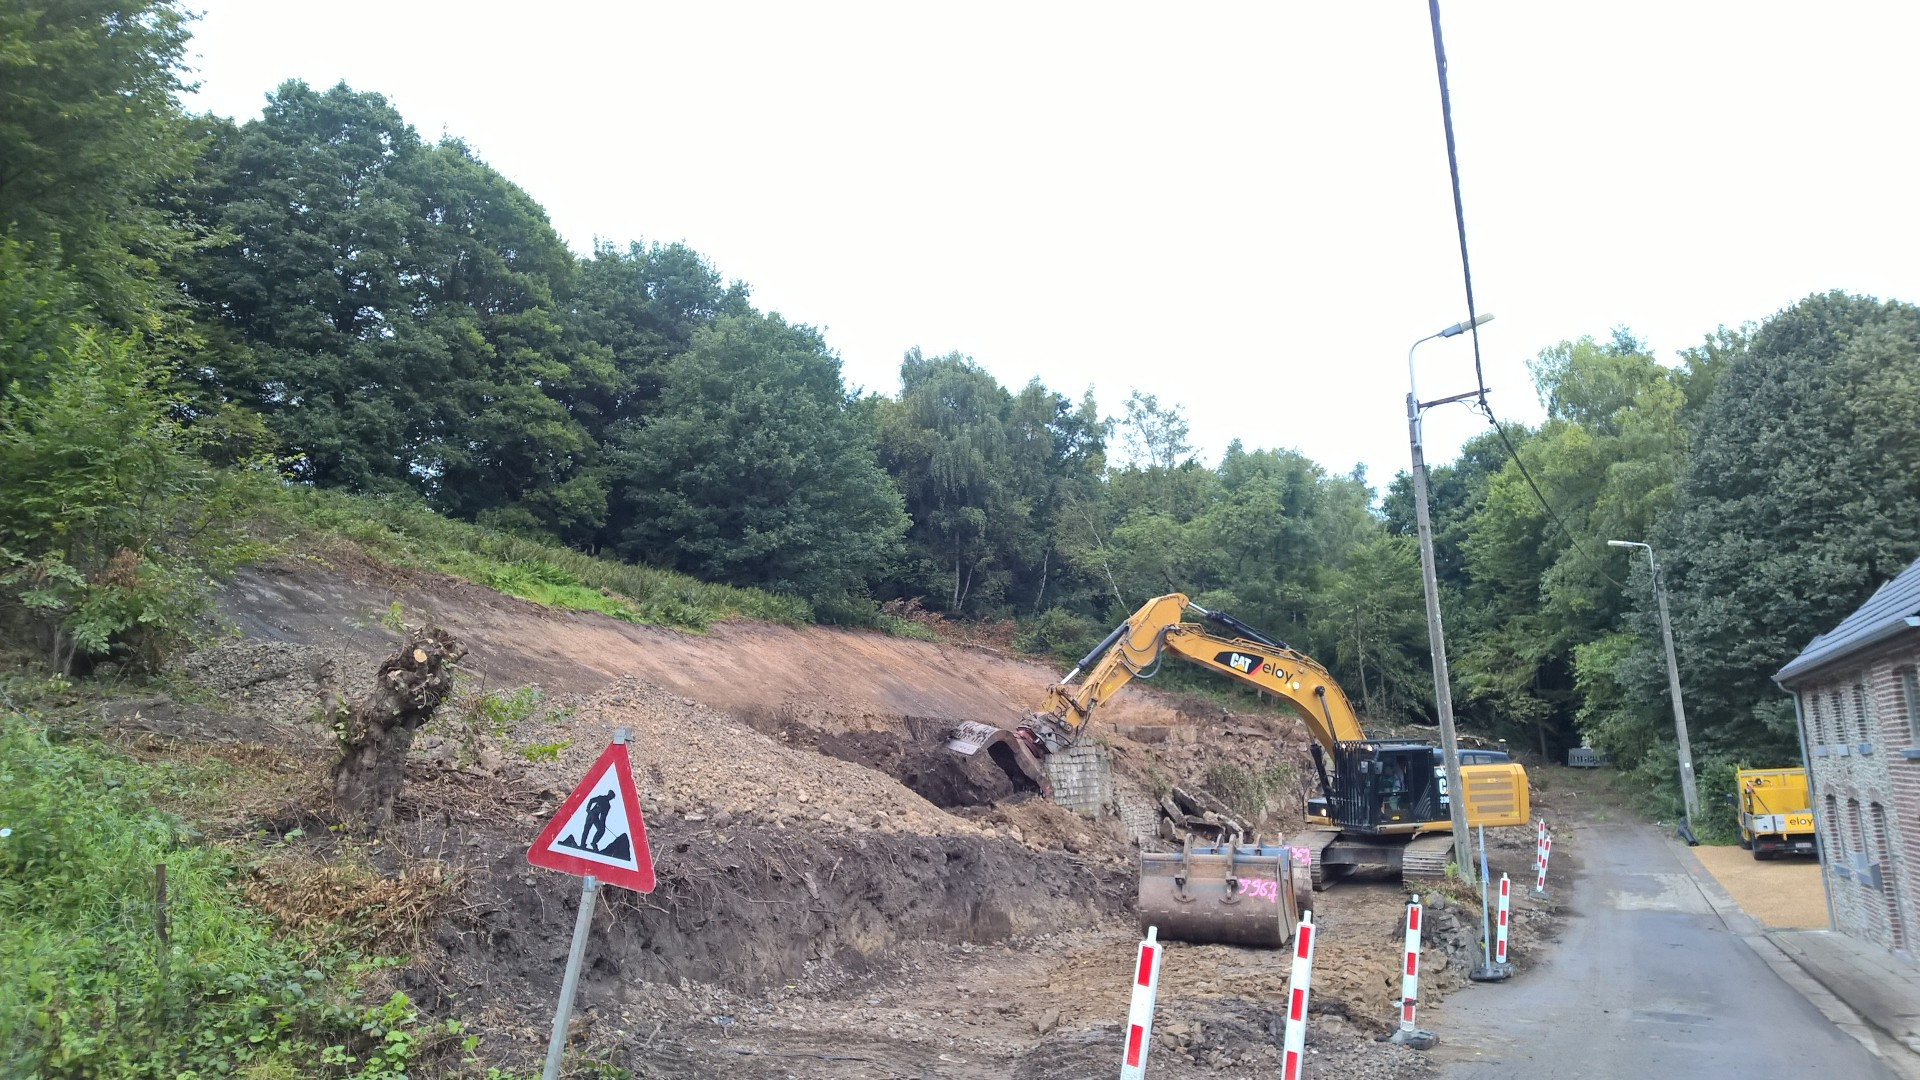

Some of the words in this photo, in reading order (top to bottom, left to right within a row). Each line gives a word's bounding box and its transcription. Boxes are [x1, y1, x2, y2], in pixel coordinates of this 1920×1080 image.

[1230, 652, 1252, 673] CAT
[1262, 662, 1294, 685] eloy
[1789, 817, 1813, 826] eloy
